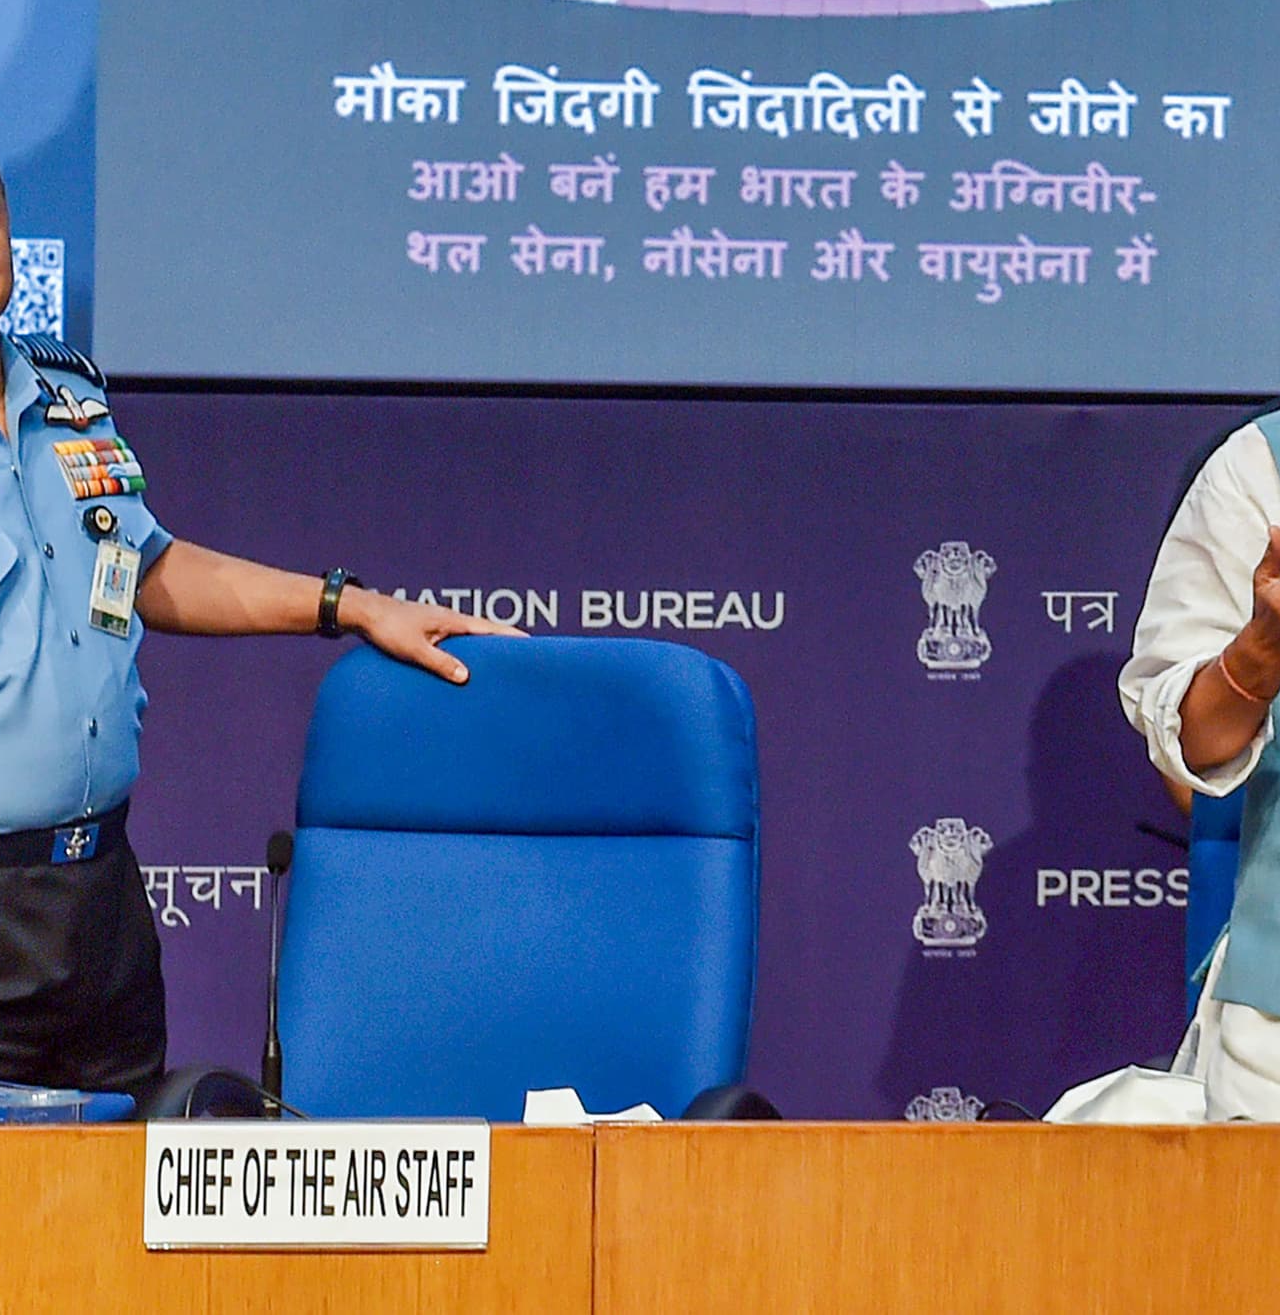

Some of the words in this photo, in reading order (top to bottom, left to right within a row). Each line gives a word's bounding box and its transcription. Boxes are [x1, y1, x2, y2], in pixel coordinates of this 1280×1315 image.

[333, 61, 467, 124] मौका
[493, 64, 660, 134] जिंदगी
[687, 69, 926, 139] जिंदादिली
[952, 76, 1002, 137] से
[1027, 78, 1138, 139] जीने
[1162, 94, 1232, 140] का
[407, 152, 524, 202] आओ
[548, 153, 620, 204] बनें
[643, 165, 716, 212] हम
[740, 166, 857, 209] भारत
[881, 159, 925, 210] के
[949, 159, 1158, 215] अग्निवीर-
[407, 230, 487, 274] थल
[510, 224, 616, 283] सेना,
[643, 225, 789, 280] नौसेना
[811, 228, 895, 283] और
[918, 234, 1092, 305] वायुसेना
[1115, 233, 1158, 286] में
[581, 590, 785, 629] BUREAU
[1041, 591, 1119, 634] पत्र
[1036, 869, 1189, 907] PRESS
[157, 1147, 234, 1216] CHIEF
[242, 1147, 277, 1216] OF
[286, 1148, 337, 1217] THE
[342, 1149, 387, 1217] AIR
[395, 1148, 476, 1217] STAFF
